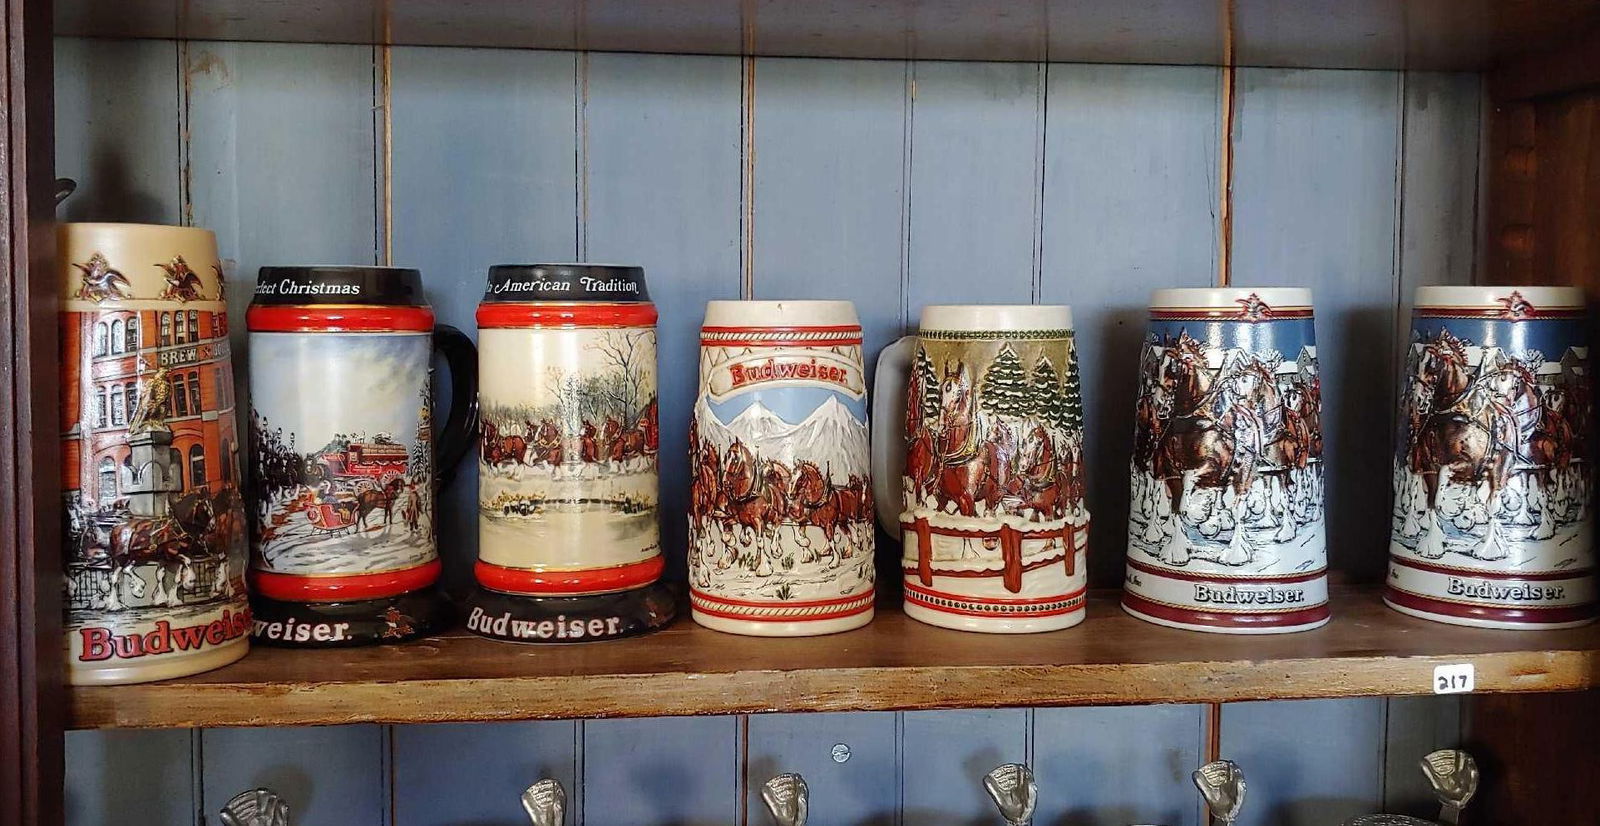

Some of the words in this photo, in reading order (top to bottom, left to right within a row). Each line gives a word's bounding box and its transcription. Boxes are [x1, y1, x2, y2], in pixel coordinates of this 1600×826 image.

[279, 278, 361, 295] Christmas
[494, 277, 571, 294] American
[580, 276, 640, 295] Tradition
[161, 348, 197, 366] BREW
[1438, 674, 1468, 690] 217
